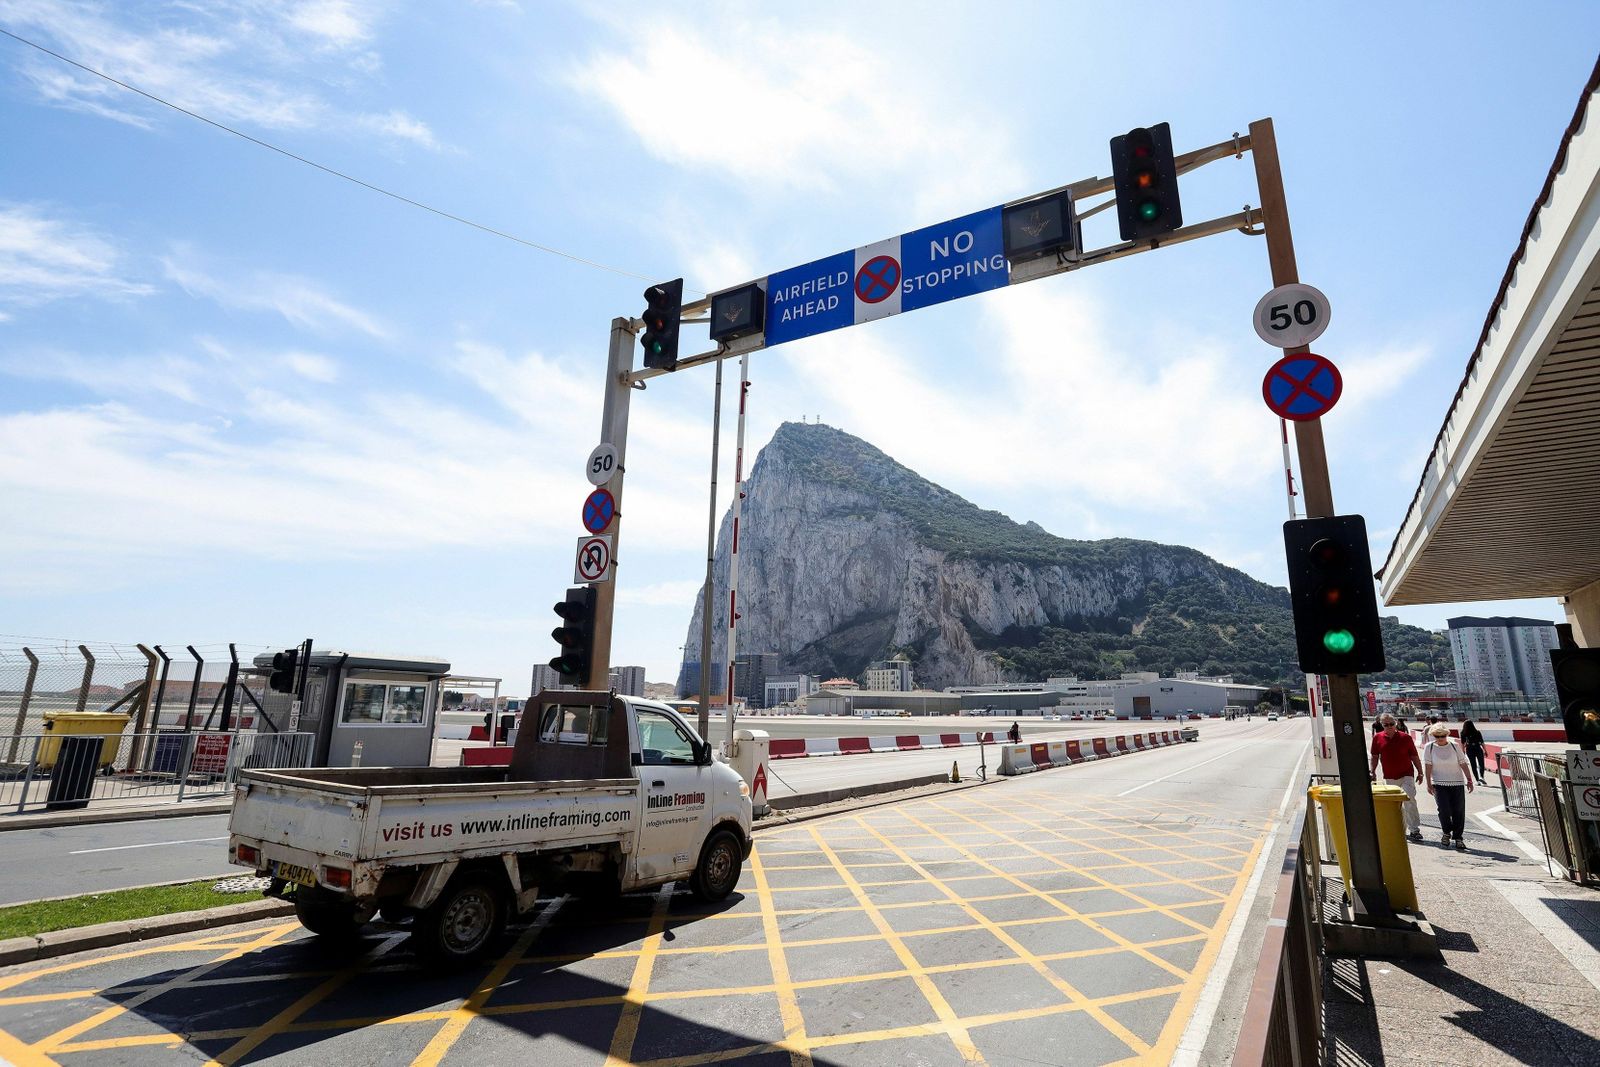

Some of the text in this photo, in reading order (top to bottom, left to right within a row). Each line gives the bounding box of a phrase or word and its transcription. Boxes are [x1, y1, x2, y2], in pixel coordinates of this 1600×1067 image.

[930, 230, 974, 261] NO
[773, 271, 849, 304] AIRFIELD
[903, 254, 1005, 294] STOPPING
[781, 295, 839, 323] AHEAD
[1270, 300, 1317, 331] 50
[592, 454, 613, 474] 50
[647, 791, 706, 809] InLine Framing
[382, 809, 631, 843] visit us www.inlineframing.com
[333, 849, 354, 859] CARRY
